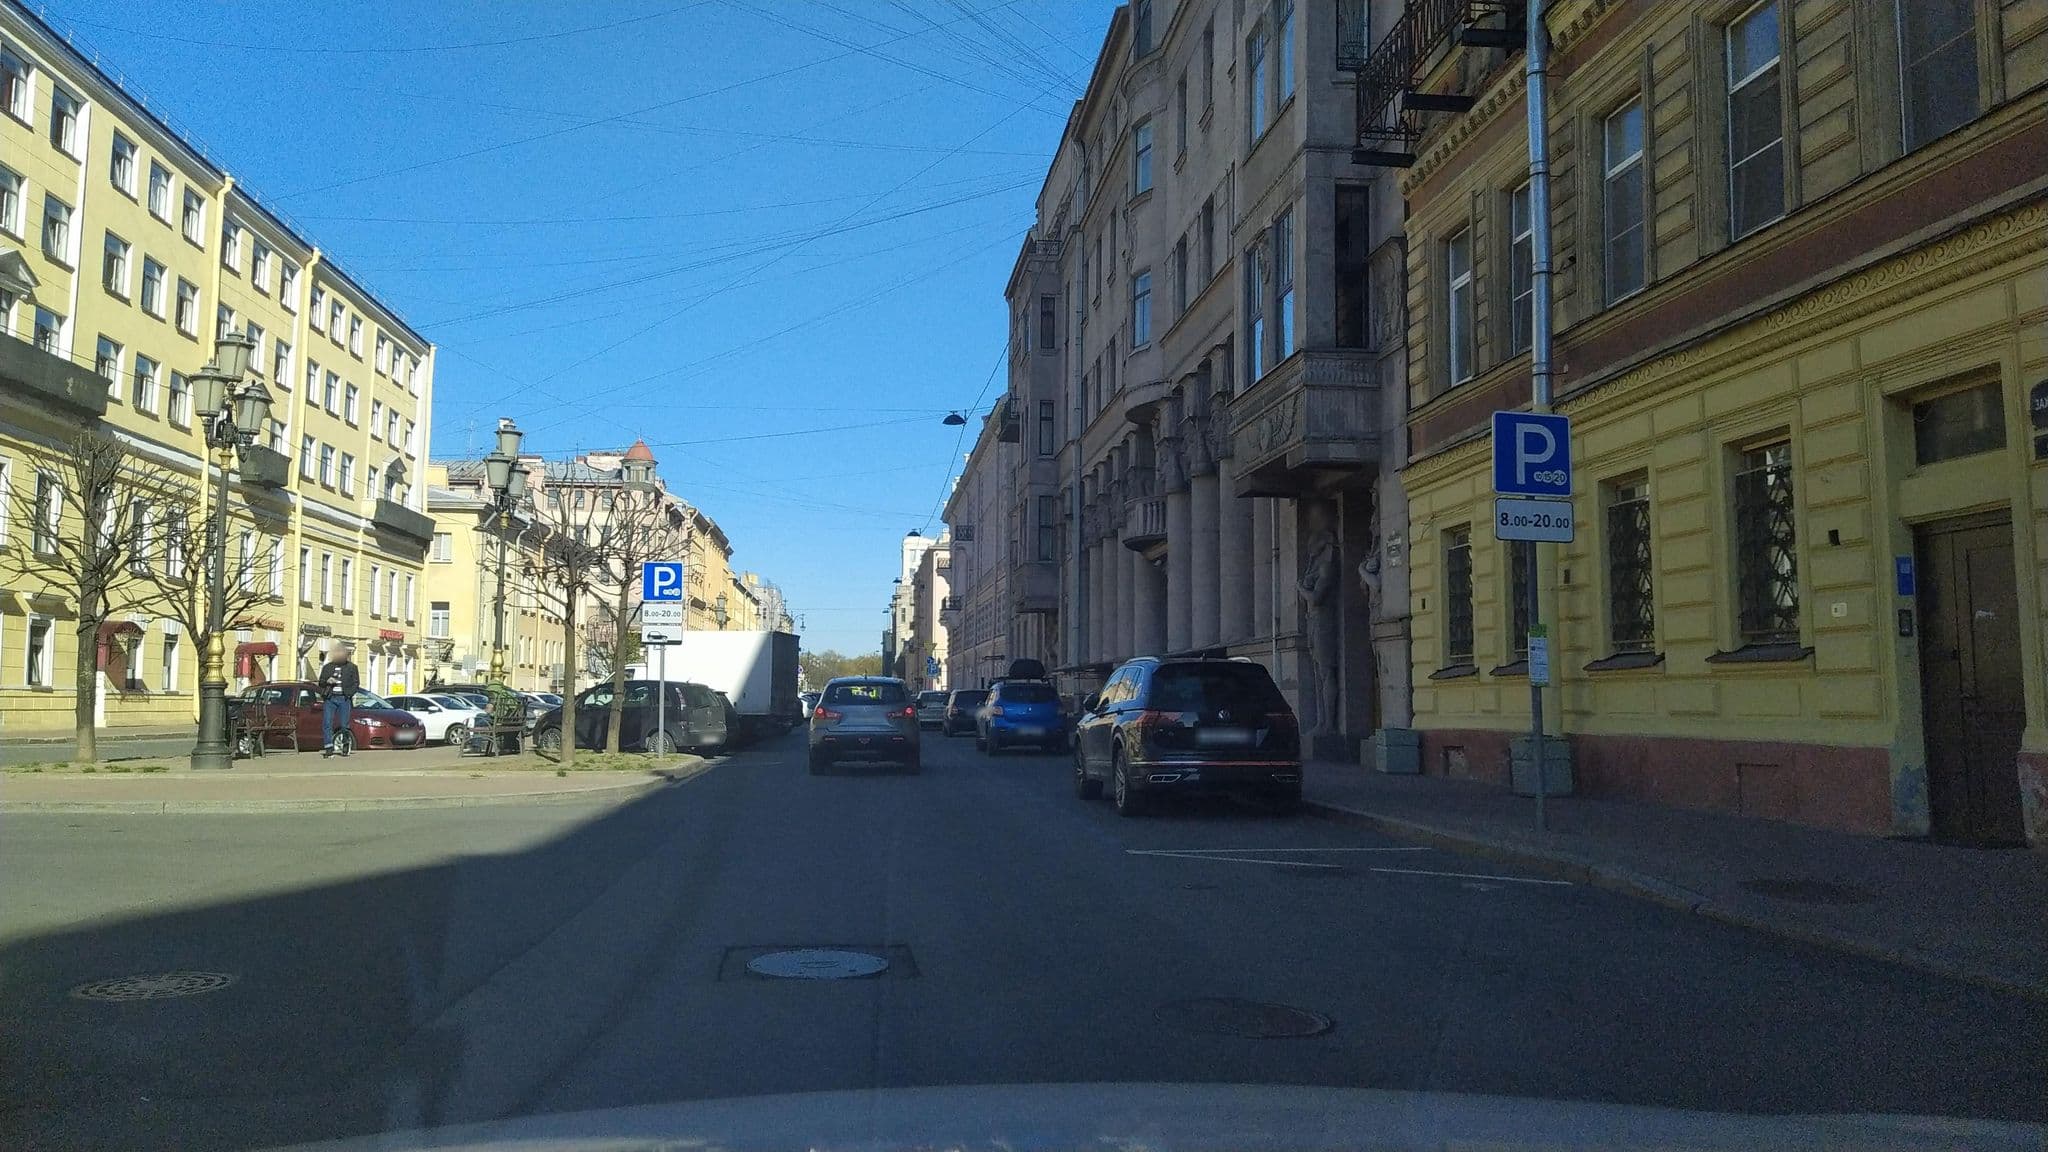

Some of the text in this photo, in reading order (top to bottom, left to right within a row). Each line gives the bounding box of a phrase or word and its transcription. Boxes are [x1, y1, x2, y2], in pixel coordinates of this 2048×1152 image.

[1515, 422, 1556, 485] P
[1500, 512, 1570, 529] 8.00-20.00
[653, 566, 676, 597] P
[644, 609, 681, 618] 8.00-20.00
